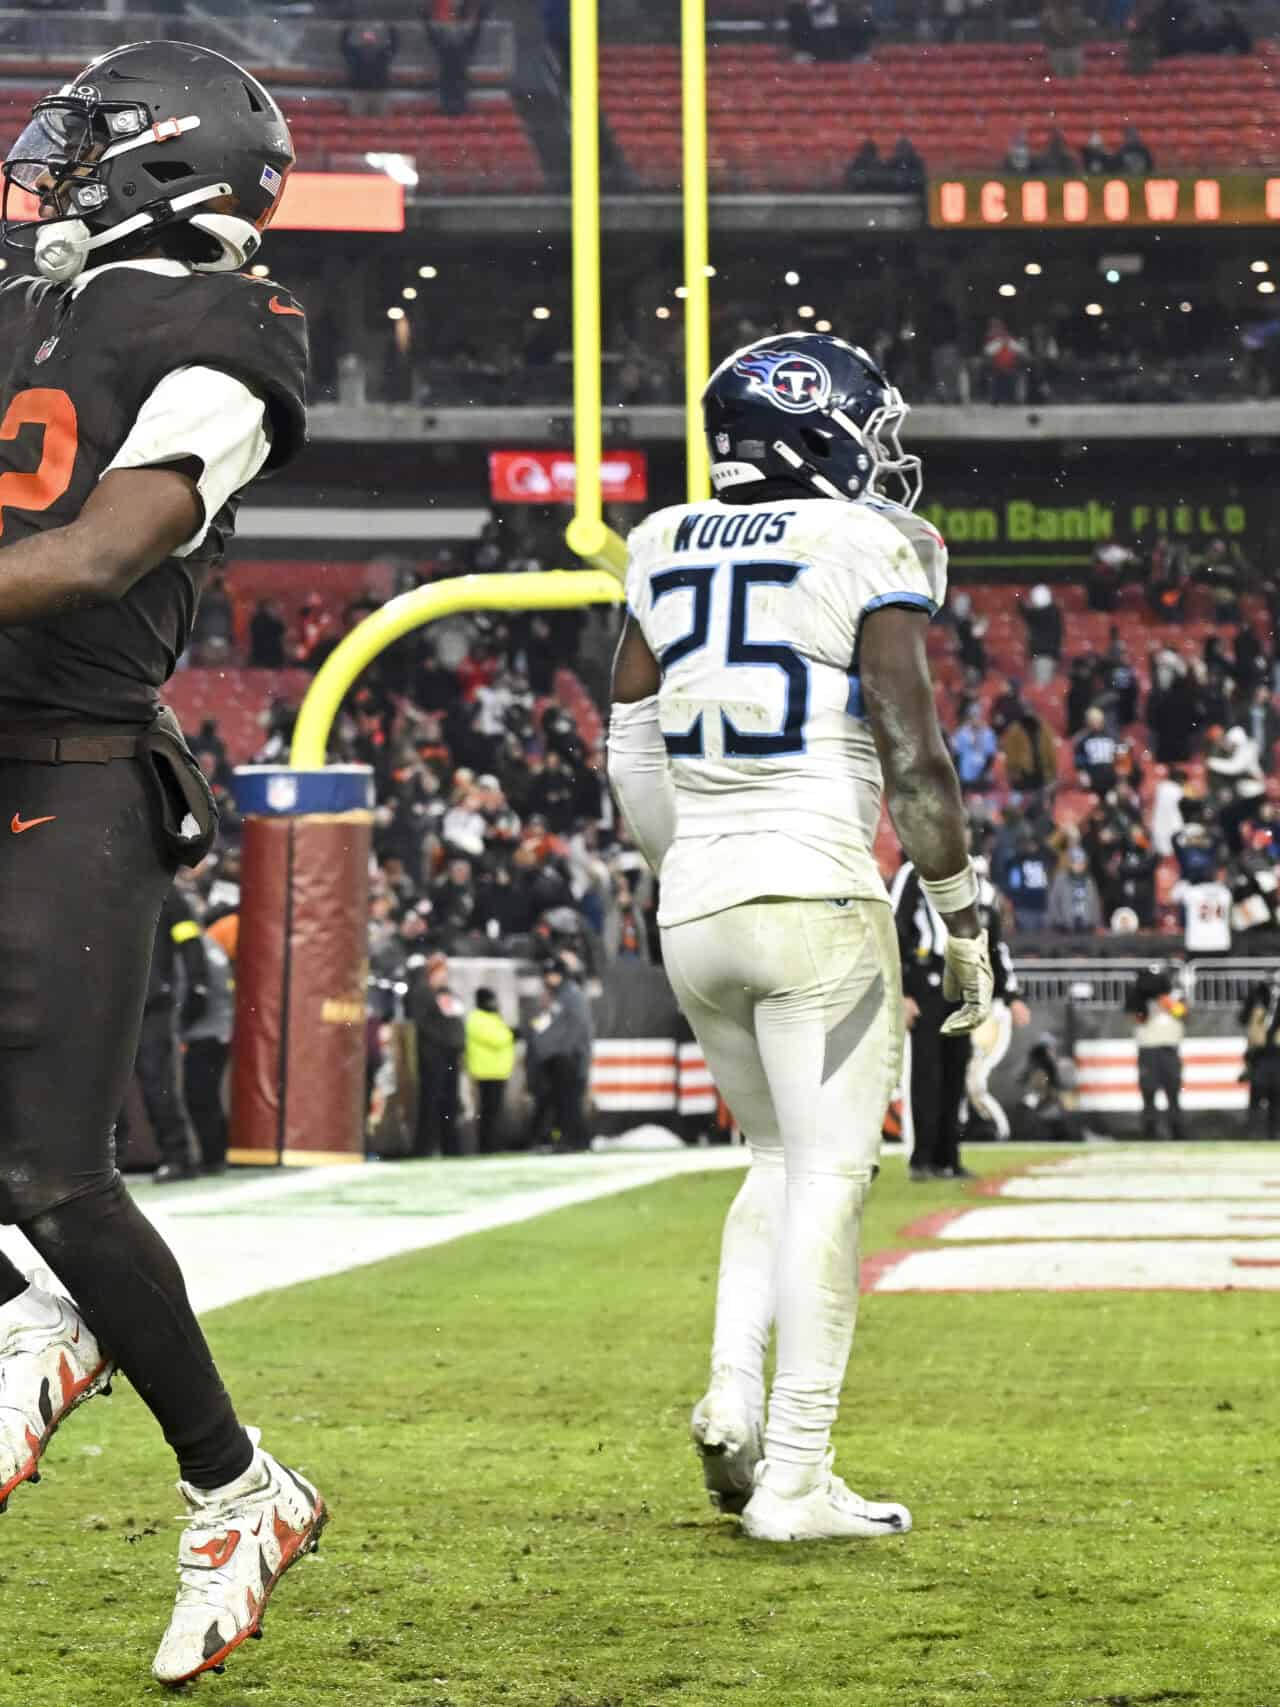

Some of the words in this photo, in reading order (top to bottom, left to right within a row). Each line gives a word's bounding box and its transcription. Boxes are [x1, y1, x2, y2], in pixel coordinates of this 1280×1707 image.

[673, 511, 797, 553] WOODS
[1007, 500, 1114, 541] Bank
[1132, 505, 1246, 534] FIELD
[650, 560, 810, 758] 25
